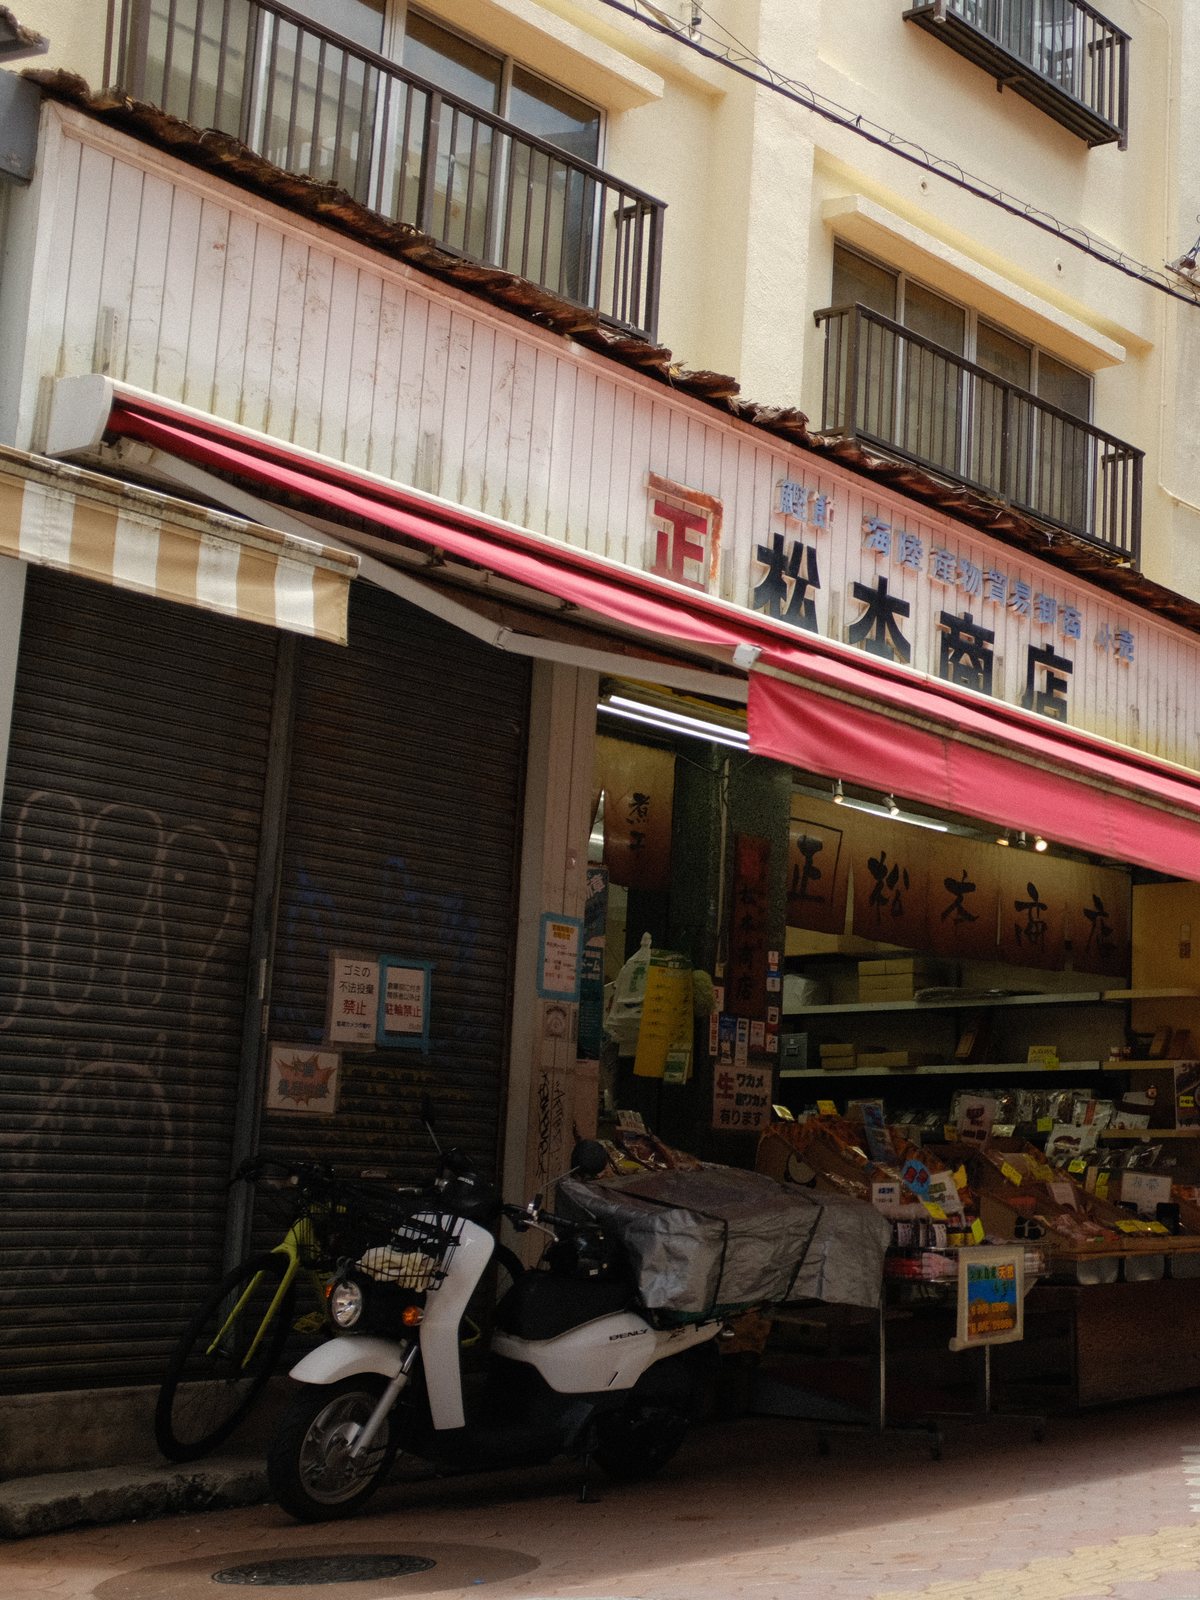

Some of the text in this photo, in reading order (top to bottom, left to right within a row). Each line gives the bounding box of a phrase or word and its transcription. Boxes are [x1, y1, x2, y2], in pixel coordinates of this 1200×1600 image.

[754, 532, 1073, 724] 松本商店
[344, 965, 371, 978] ゴミの
[339, 981, 374, 995] 不法投棄
[343, 999, 367, 1016] 禁止
[385, 1003, 422, 1018] 駐輪禁止
[737, 1073, 764, 1088] ワカメ
[720, 1109, 763, 1126] 有ります
[609, 1328, 648, 1341] BENLY
